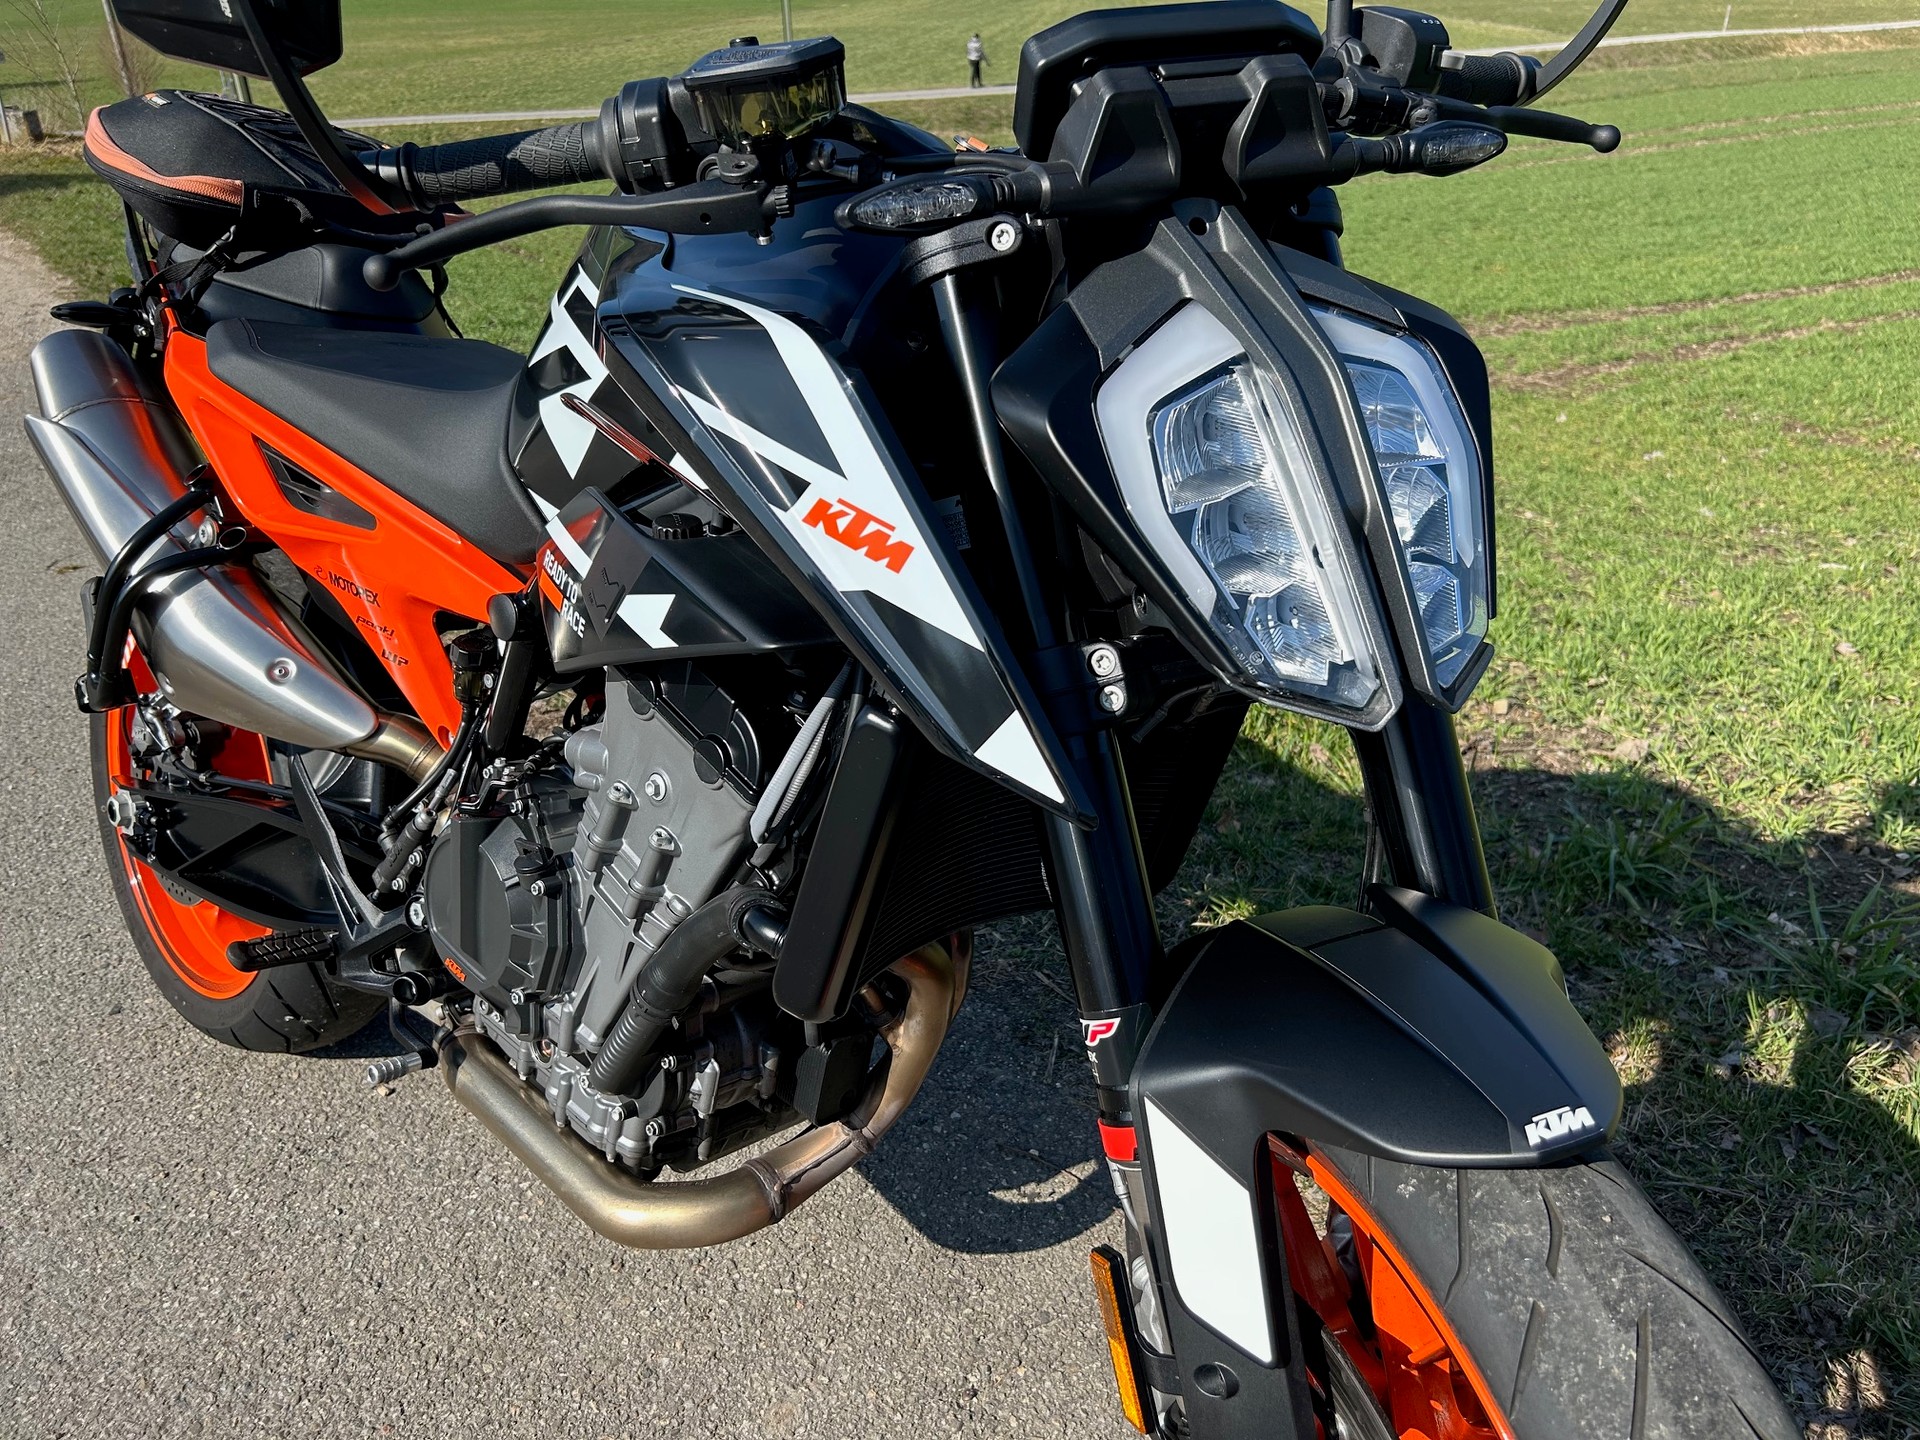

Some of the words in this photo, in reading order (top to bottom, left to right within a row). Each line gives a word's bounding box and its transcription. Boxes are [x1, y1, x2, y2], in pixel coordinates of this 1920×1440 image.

[802, 498, 915, 574] KTM
[328, 571, 381, 608] MOTOREX
[543, 549, 568, 590] READY
[566, 576, 578, 604] TO
[561, 597, 586, 639] RACE
[444, 957, 467, 982] KTM
[1524, 1105, 1596, 1147] KTM
